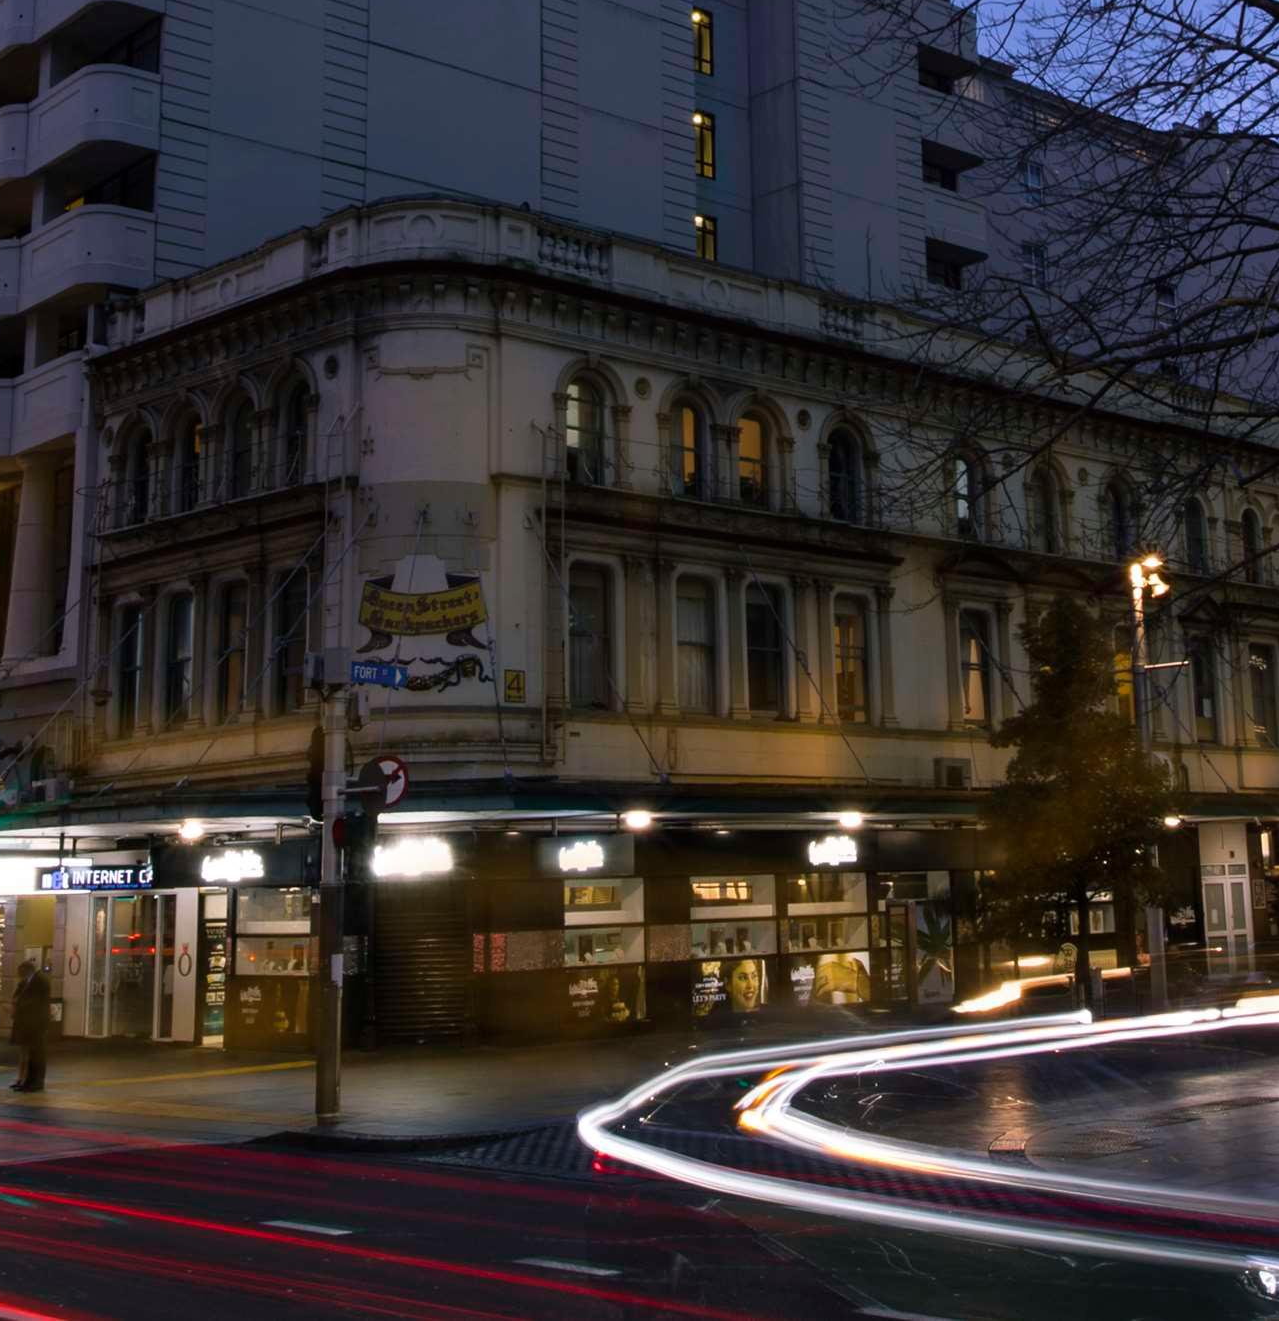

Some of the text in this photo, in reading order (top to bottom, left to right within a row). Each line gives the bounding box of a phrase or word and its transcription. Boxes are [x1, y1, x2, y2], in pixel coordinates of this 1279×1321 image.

[353, 665, 378, 679] FORT
[506, 673, 523, 695] 4
[71, 869, 134, 885] INTERNET
